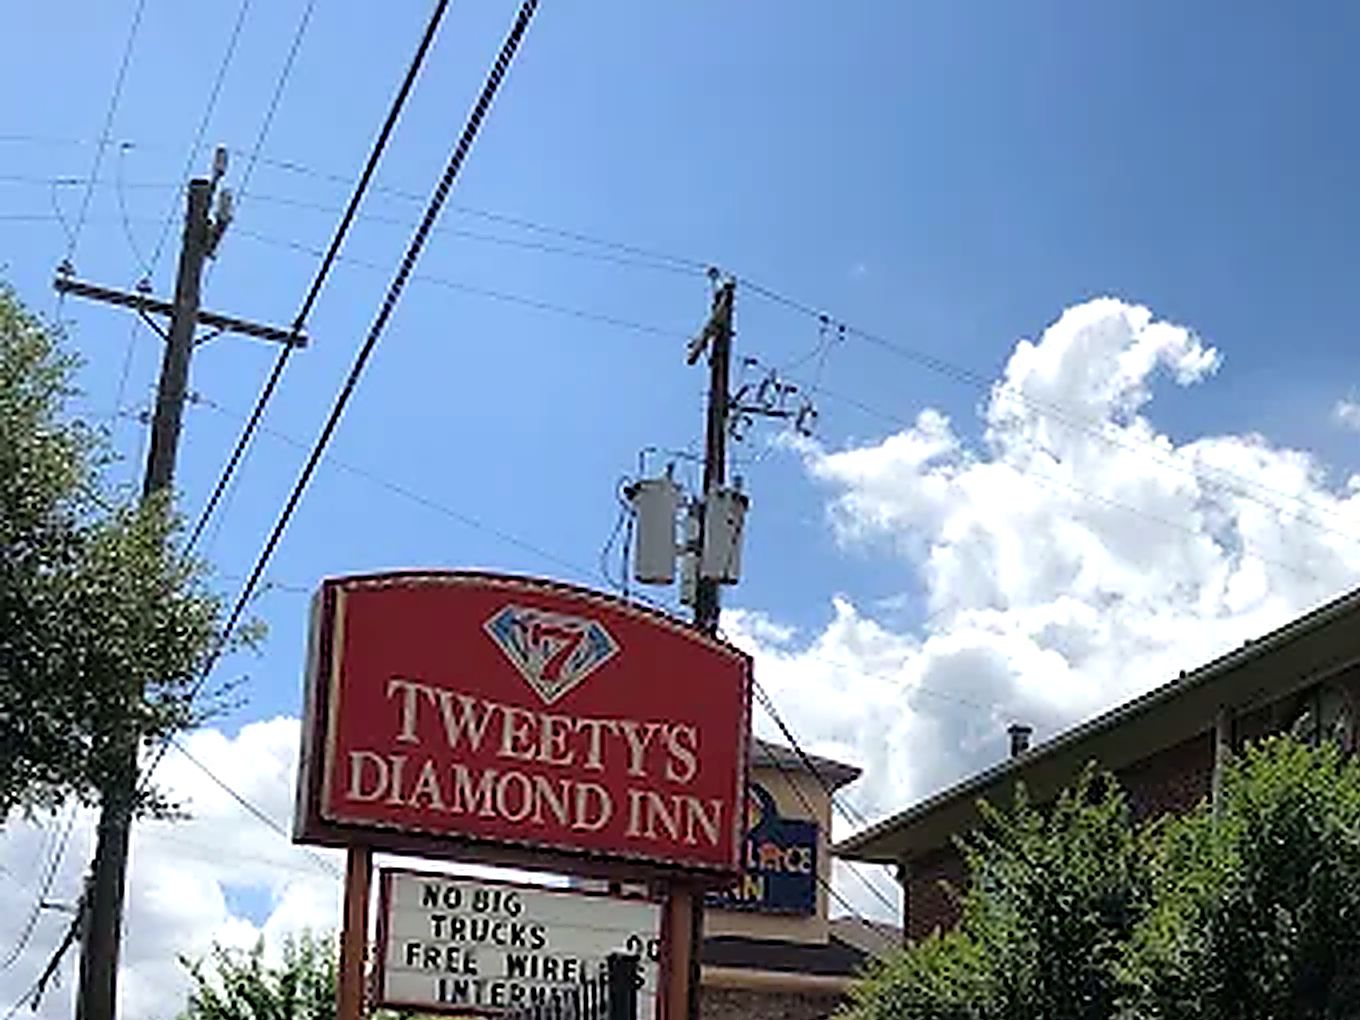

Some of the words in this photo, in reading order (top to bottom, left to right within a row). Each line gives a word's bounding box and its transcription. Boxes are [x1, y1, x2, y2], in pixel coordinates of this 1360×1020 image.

[386, 679, 697, 783] TWEETY'S
[347, 750, 616, 832] DIAMOND
[626, 788, 724, 846] INN
[421, 884, 462, 909] NO
[472, 889, 522, 917] BIG
[431, 914, 546, 949] TRUCKS
[406, 943, 478, 976] FREE
